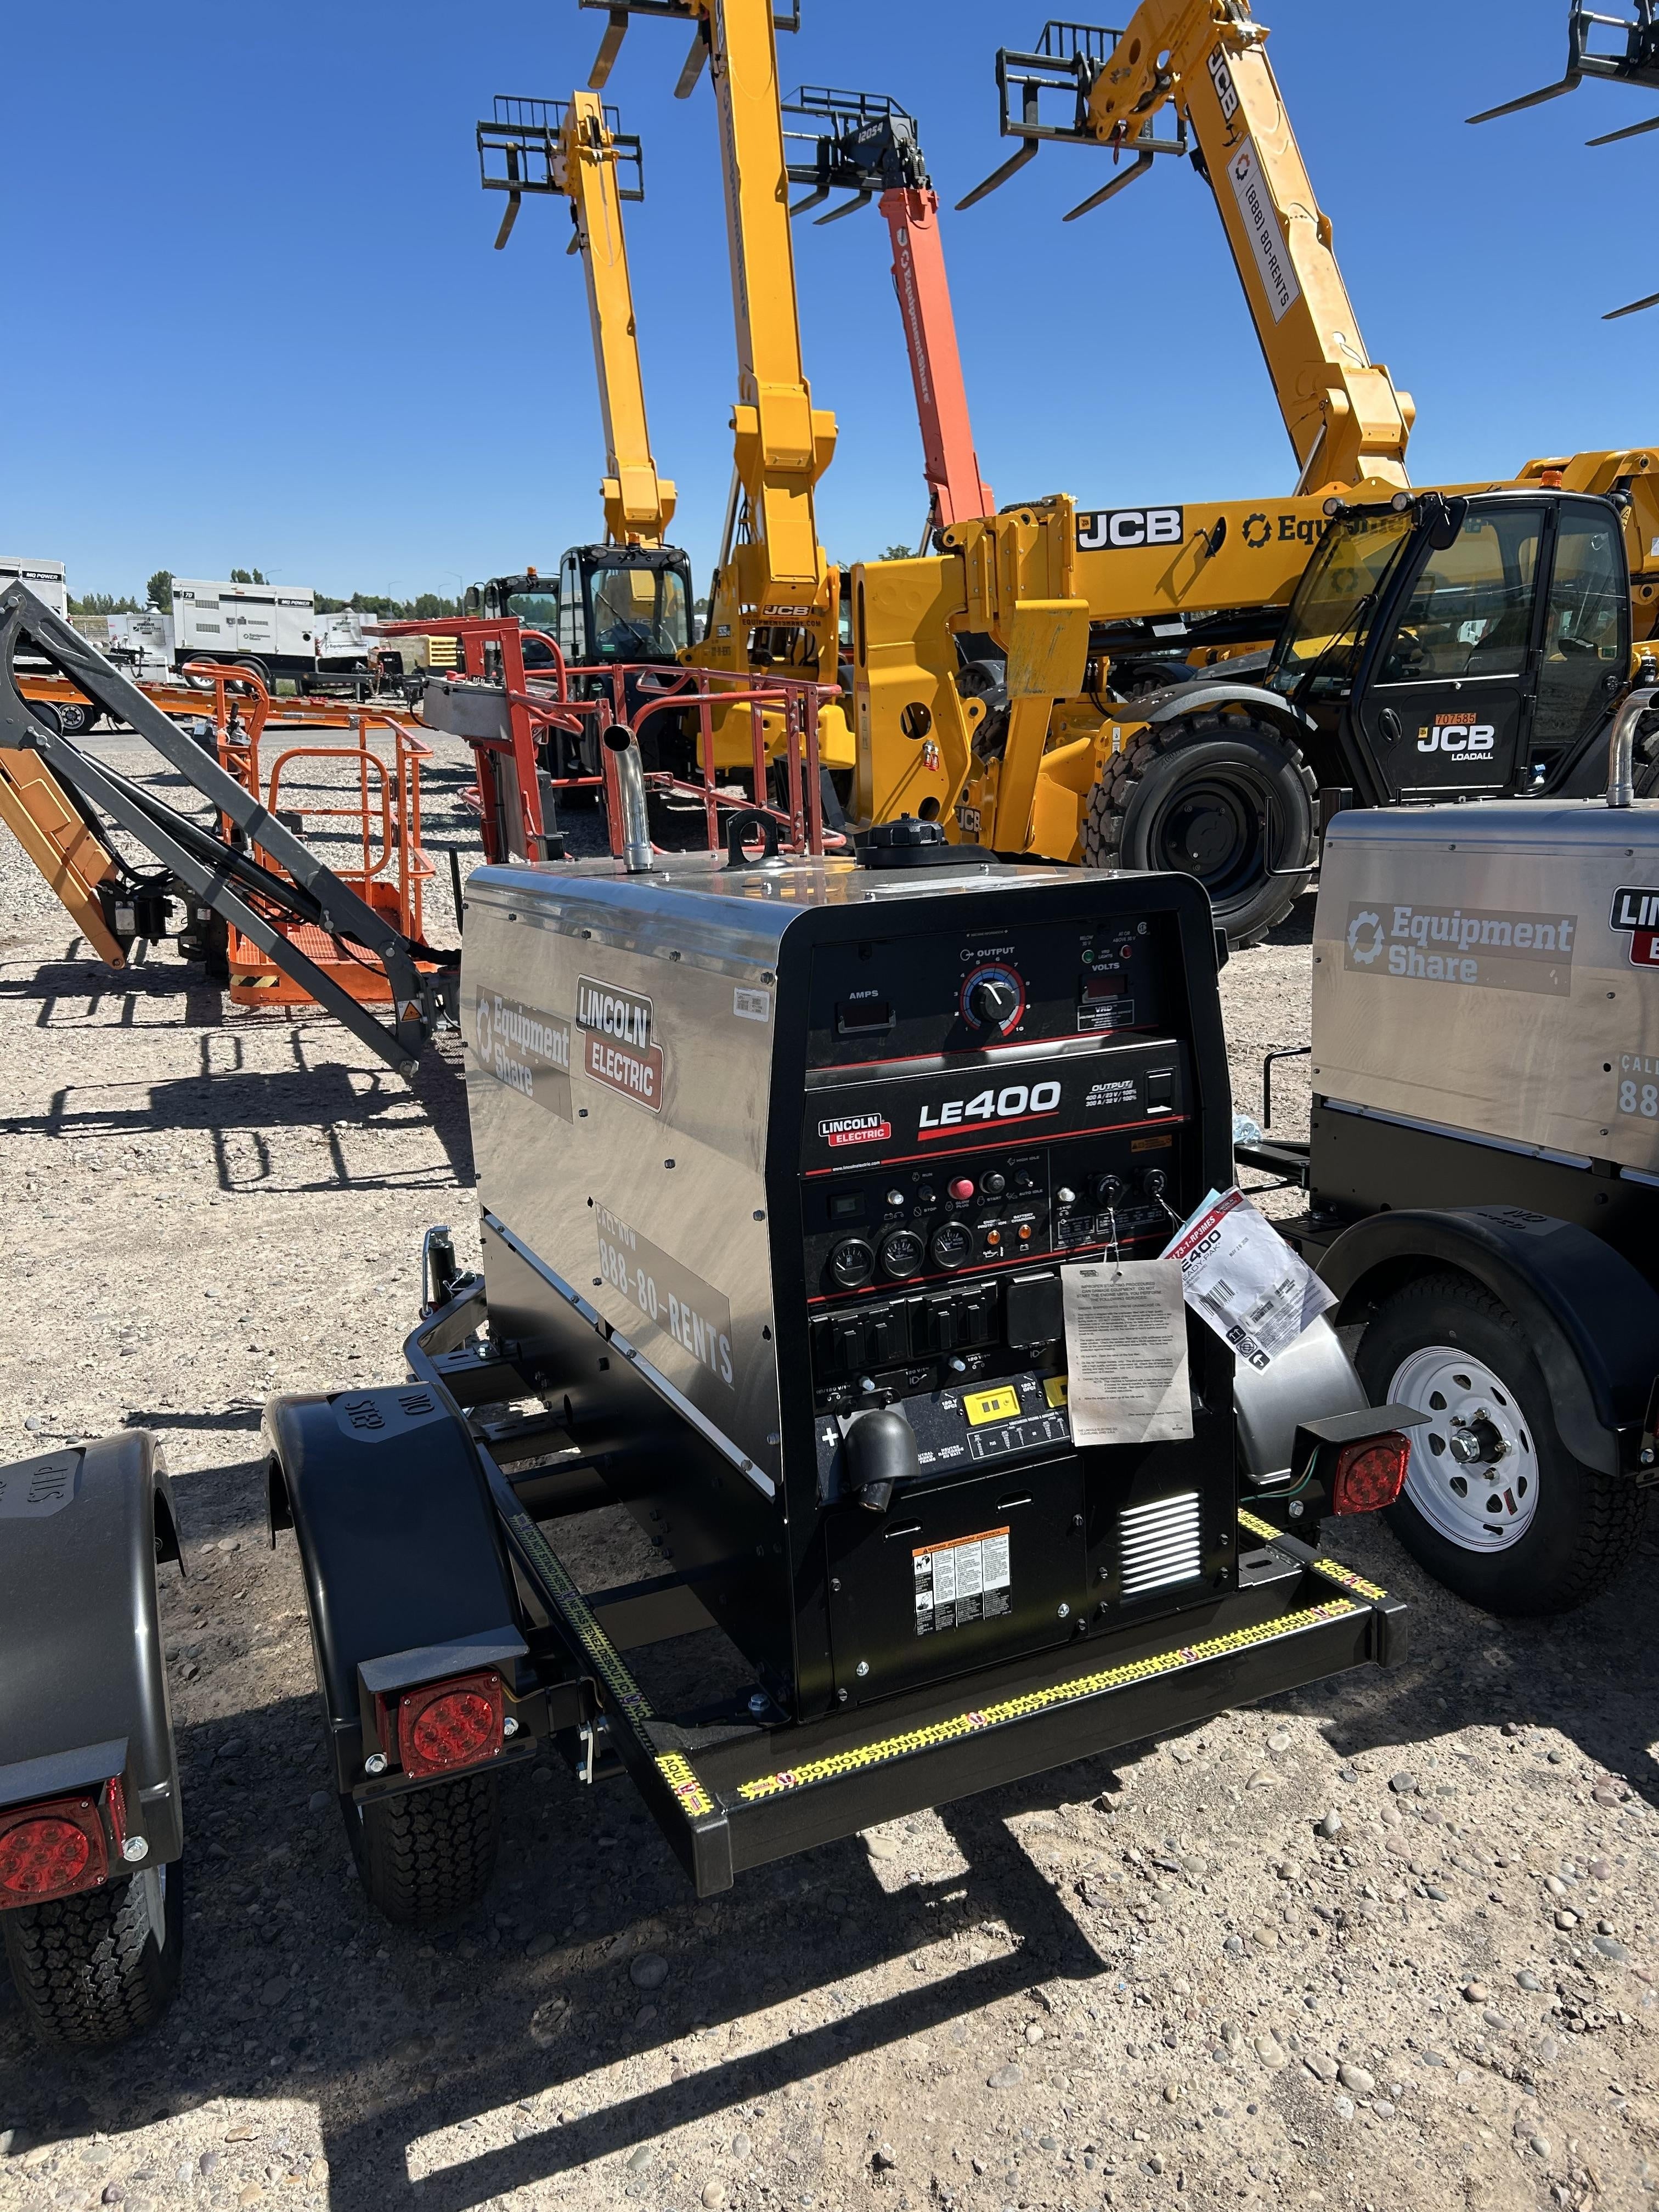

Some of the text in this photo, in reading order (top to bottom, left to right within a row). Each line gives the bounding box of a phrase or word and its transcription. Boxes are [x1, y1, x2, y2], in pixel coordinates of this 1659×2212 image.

[1209, 52, 1238, 120] JCB
[1245, 184, 1289, 307] (888) 80-RENTS
[1079, 510, 1181, 548] JCB
[764, 606, 809, 615] JCB
[1436, 714, 1476, 724] 707585
[1418, 725, 1494, 753] JCB
[1451, 752, 1493, 761] LOADALL
[958, 809, 980, 832] JCB
[1391, 906, 1573, 952] Equipment
[977, 947, 1015, 957] OUTPUT
[1092, 962, 1120, 972] VOLTS
[1388, 944, 1478, 984] Share
[849, 990, 879, 1000] AMPS
[579, 986, 648, 1050] LINCOLN
[493, 994, 571, 1068] Equipment
[494, 1042, 533, 1097] Share
[591, 1041, 653, 1098] ELECTRIC
[1091, 1080, 1131, 1092] OUTPUT
[919, 1081, 1062, 1128] LE400
[822, 1116, 878, 1134] LINCOLN
[836, 1128, 884, 1143] ELECTRIC
[832, 1160, 881, 1172] www.lincolnelectric.com
[1503, 1210, 1547, 1222] NO
[618, 1219, 636, 1251] NOW
[600, 1238, 734, 1386] 888-80-RENTS
[345, 1400, 386, 1430] STEP
[398, 1393, 435, 1415] NO
[27, 1466, 69, 1503] STEP
[1239, 1515, 1267, 1533] HERE
[532, 1538, 545, 1555] NOT
[538, 1552, 559, 1578] STAND
[1327, 1566, 1346, 1576] DO
[552, 1575, 569, 1593] HERE
[568, 1599, 582, 1613] NE
[573, 1609, 588, 1626] PAS
[582, 1623, 605, 1651] TENEZ
[597, 1647, 624, 1685] DEBOUT
[615, 1680, 633, 1696] ICI
[631, 1703, 647, 1720] NO
[797, 1765, 824, 1779] DO
[826, 1753, 863, 1770] NOT
[865, 1736, 922, 1758] STAND
[924, 1719, 968, 1739] HERE
[986, 1706, 1011, 1719] NE
[1012, 1695, 1043, 1711] PAS
[1042, 1681, 1093, 1699] TENEZ
[1094, 1663, 1156, 1684] DEBOUT
[1158, 1656, 1179, 1667] ICI
[1197, 1643, 1221, 1655] NO
[1221, 1636, 1243, 1646] SE
[1242, 1624, 1280, 1641] PARE
